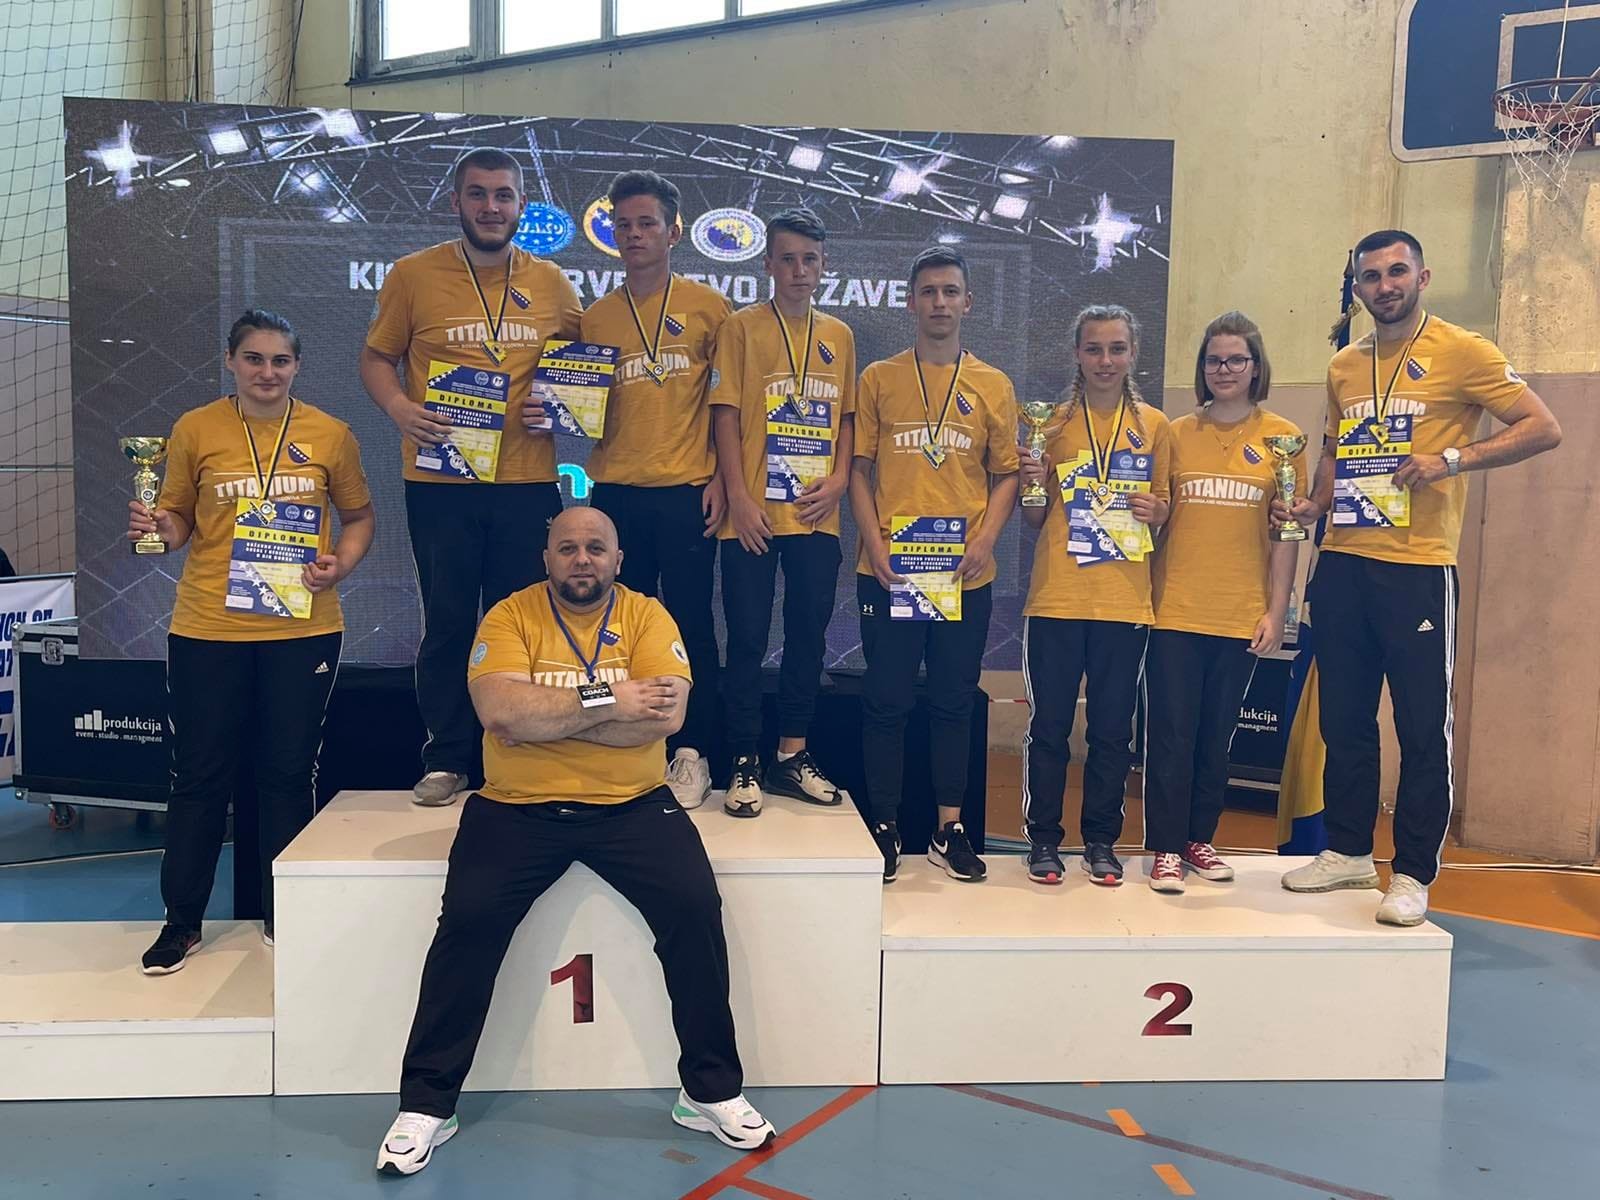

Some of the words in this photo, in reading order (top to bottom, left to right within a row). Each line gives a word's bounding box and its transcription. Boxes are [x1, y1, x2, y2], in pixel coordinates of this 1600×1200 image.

[551, 361, 601, 371] DIPLOMA
[440, 394, 493, 410] DIPLOMA
[778, 426, 821, 437] DIPLOMA
[1348, 446, 1398, 456] DIPLOMA
[1179, 477, 1264, 501] TITANIUM
[249, 530, 305, 544] DIPLOMA
[582, 687, 610, 697] COACH
[103, 715, 162, 735] produkcija
[550, 953, 594, 1024] 1
[1141, 982, 1193, 1036] 2
